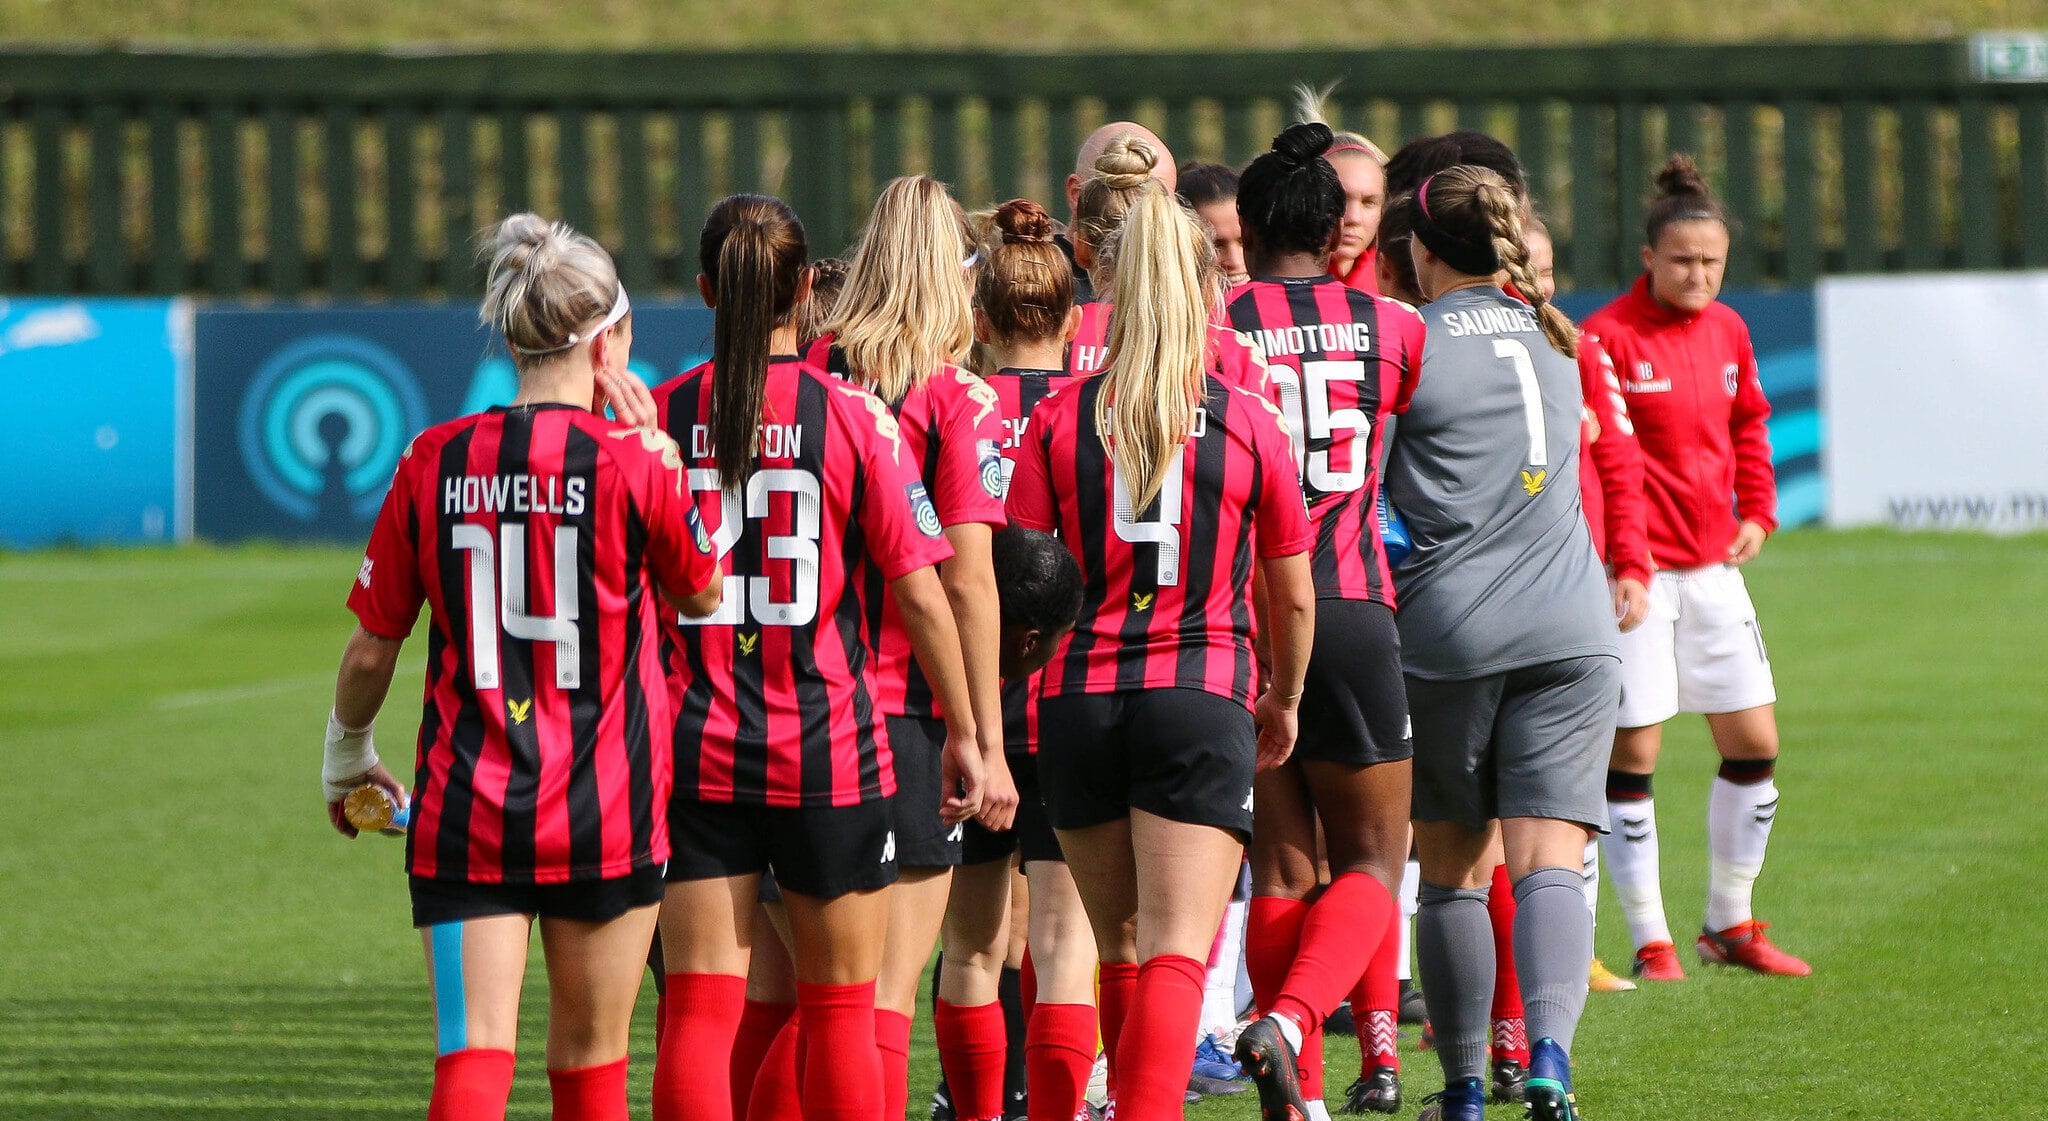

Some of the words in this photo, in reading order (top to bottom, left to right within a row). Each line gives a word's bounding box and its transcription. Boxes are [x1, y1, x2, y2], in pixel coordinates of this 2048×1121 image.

[1491, 338, 1548, 466] 1
[444, 475, 585, 514] HOWELLS
[678, 468, 820, 625] 23
[1113, 443, 1185, 586] 4
[452, 523, 580, 690] 14
